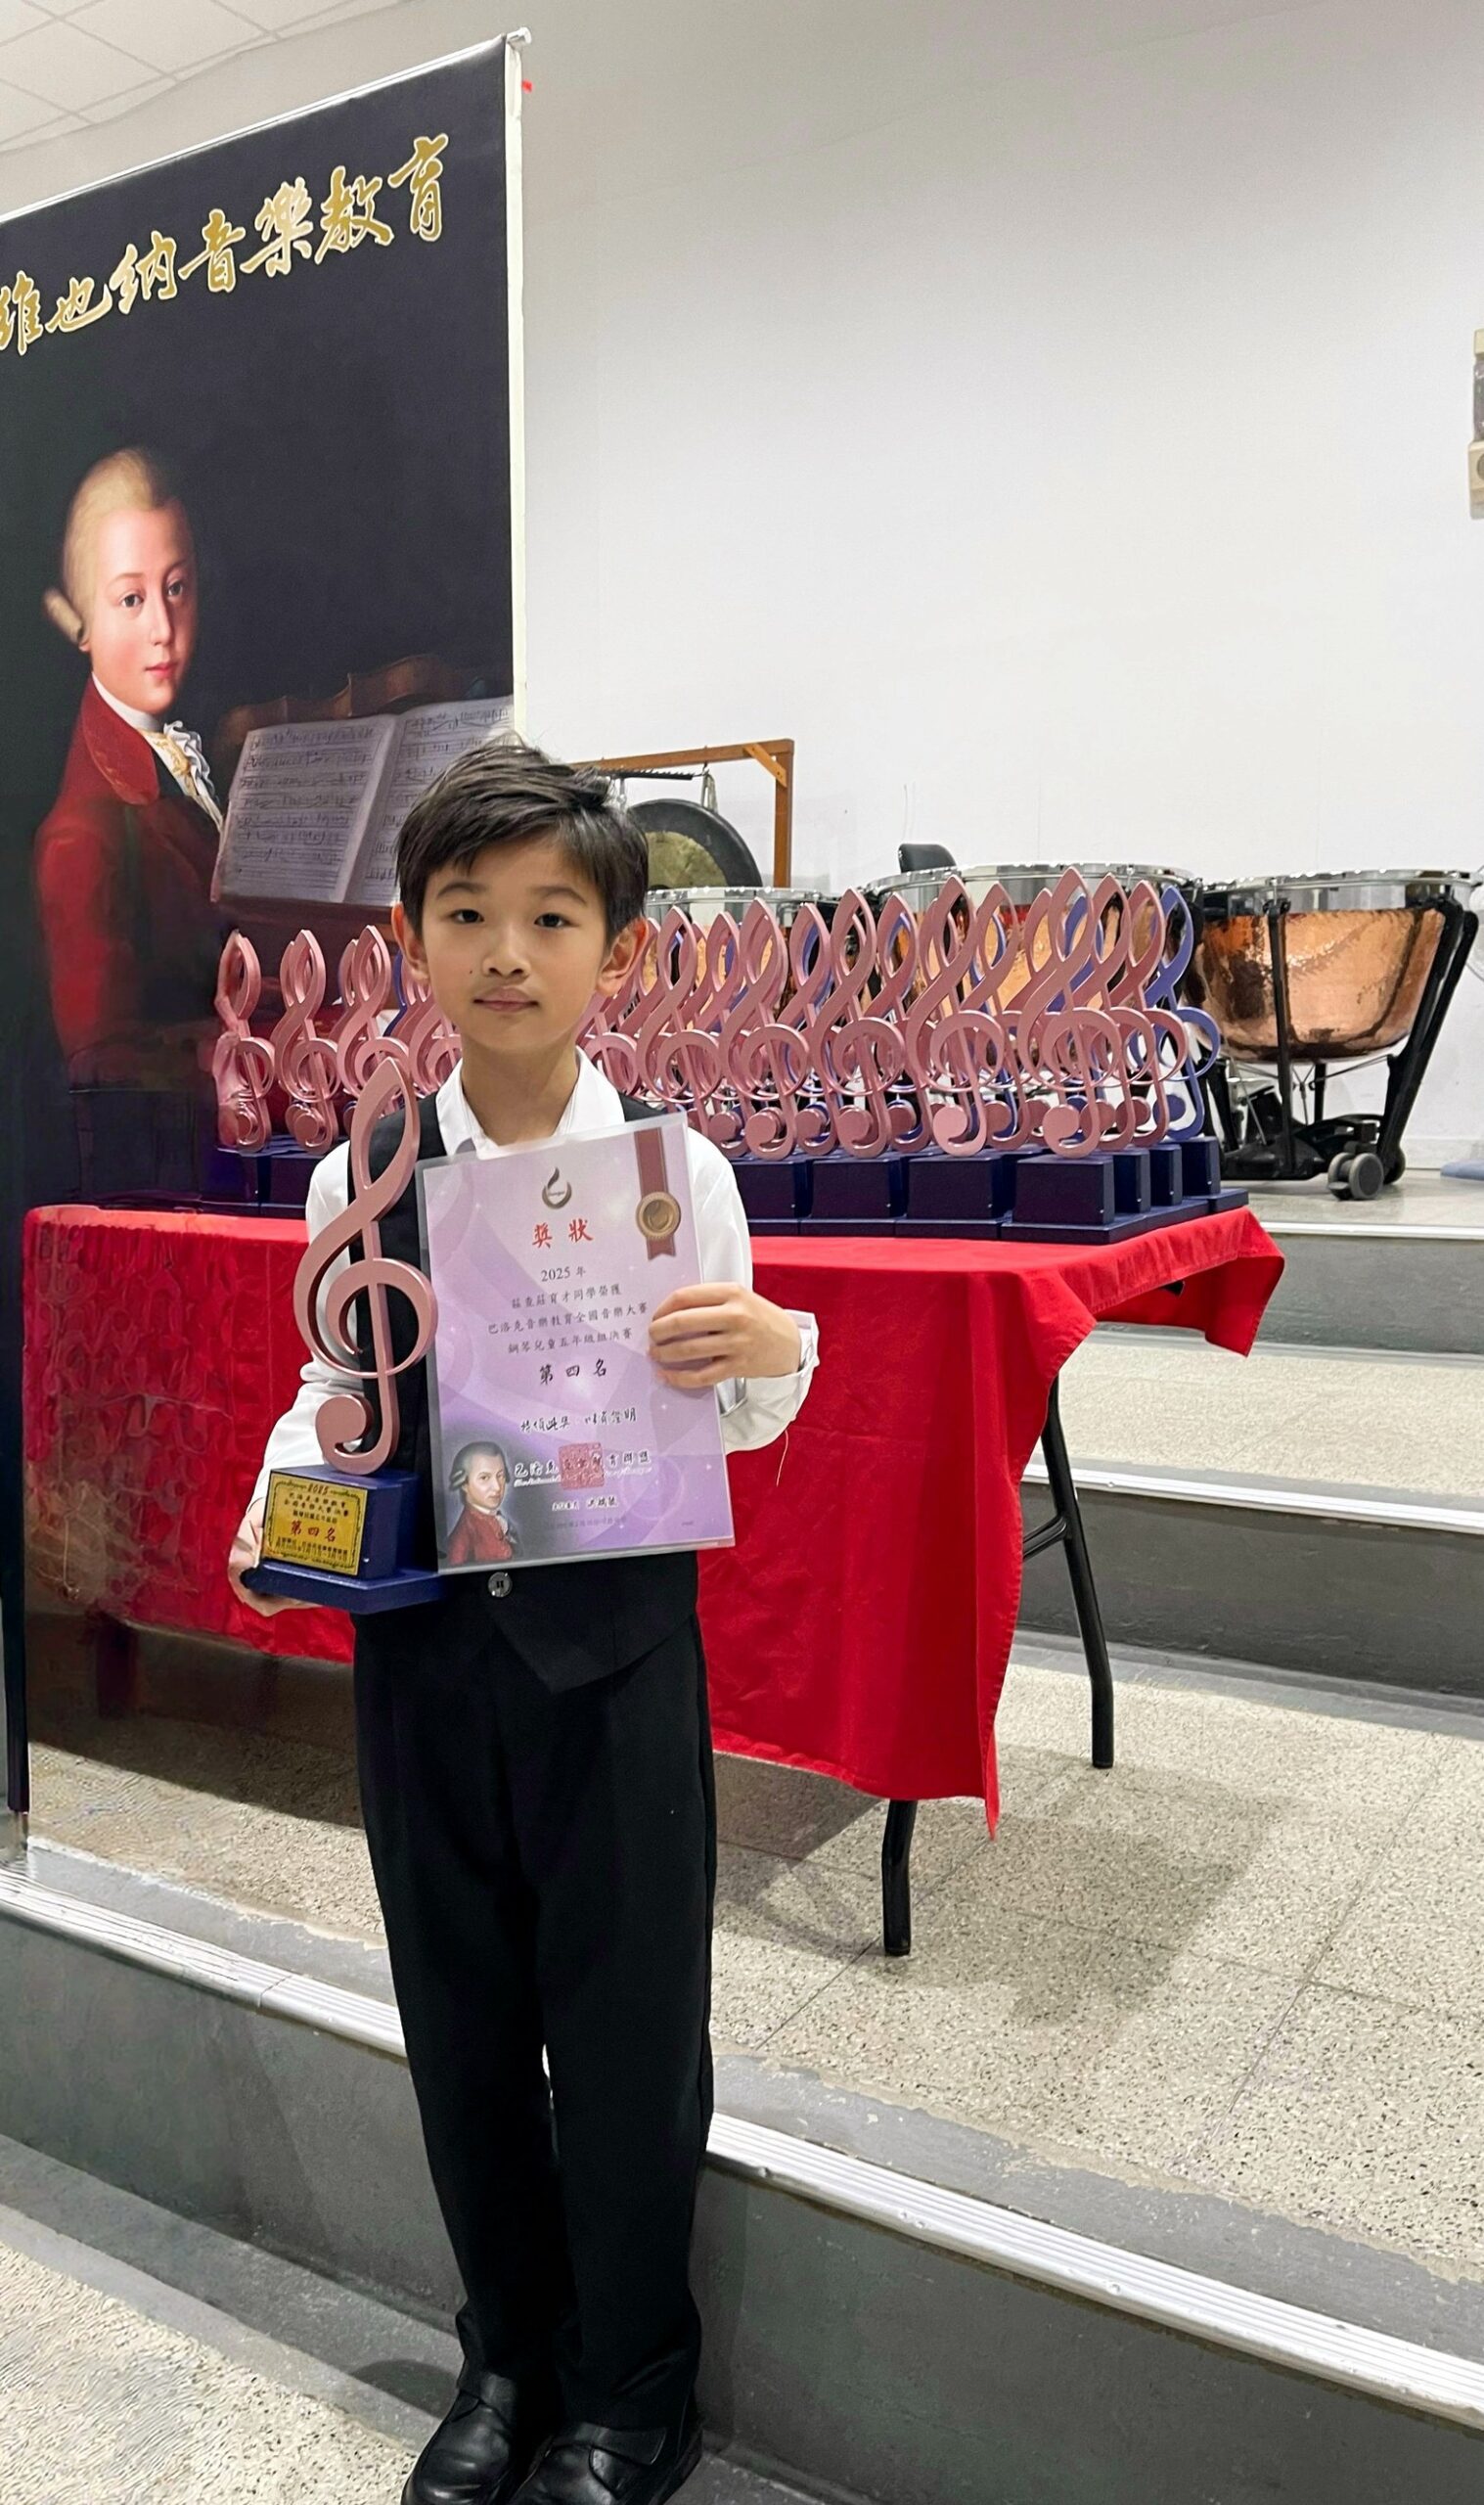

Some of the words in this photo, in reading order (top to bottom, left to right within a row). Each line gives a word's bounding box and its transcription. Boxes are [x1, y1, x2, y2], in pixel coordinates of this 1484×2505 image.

[541, 1266, 570, 1282] 2025
[575, 1265, 587, 1278] 年
[539, 1358, 607, 1386] 第四名
[291, 1519, 337, 1543] 第四名
